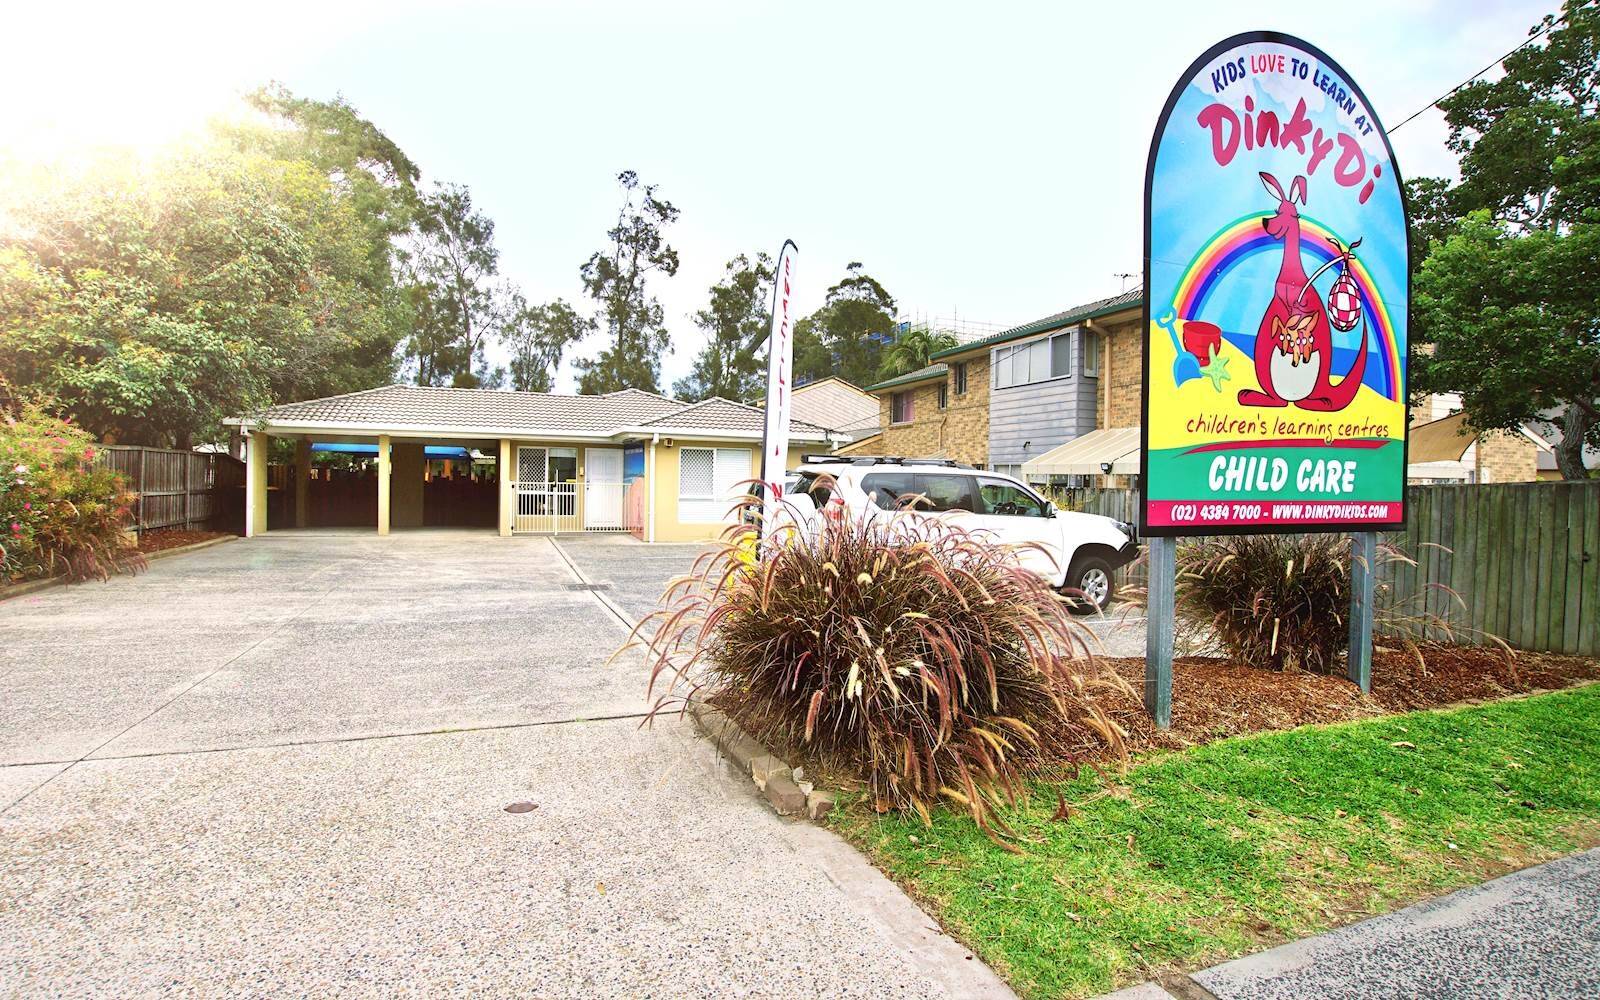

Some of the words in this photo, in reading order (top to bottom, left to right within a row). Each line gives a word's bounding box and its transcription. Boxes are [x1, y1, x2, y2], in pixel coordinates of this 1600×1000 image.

[1211, 56, 1247, 93] KIDS
[1251, 54, 1285, 74] LOVE
[1291, 57, 1309, 80] TO
[1312, 68, 1356, 115] LEARN
[1354, 114, 1374, 137] AT
[1186, 413, 1267, 435] children's
[1272, 415, 1333, 445] learning
[1338, 416, 1389, 438] centres
[1208, 454, 1289, 492] CHILD
[1296, 459, 1357, 495] CARE
[1171, 504, 1197, 521] (02)
[1200, 503, 1230, 520] 4384
[1232, 504, 1262, 520] 7000
[1272, 503, 1388, 520] WWW.DINKYDIKIDS.COM
